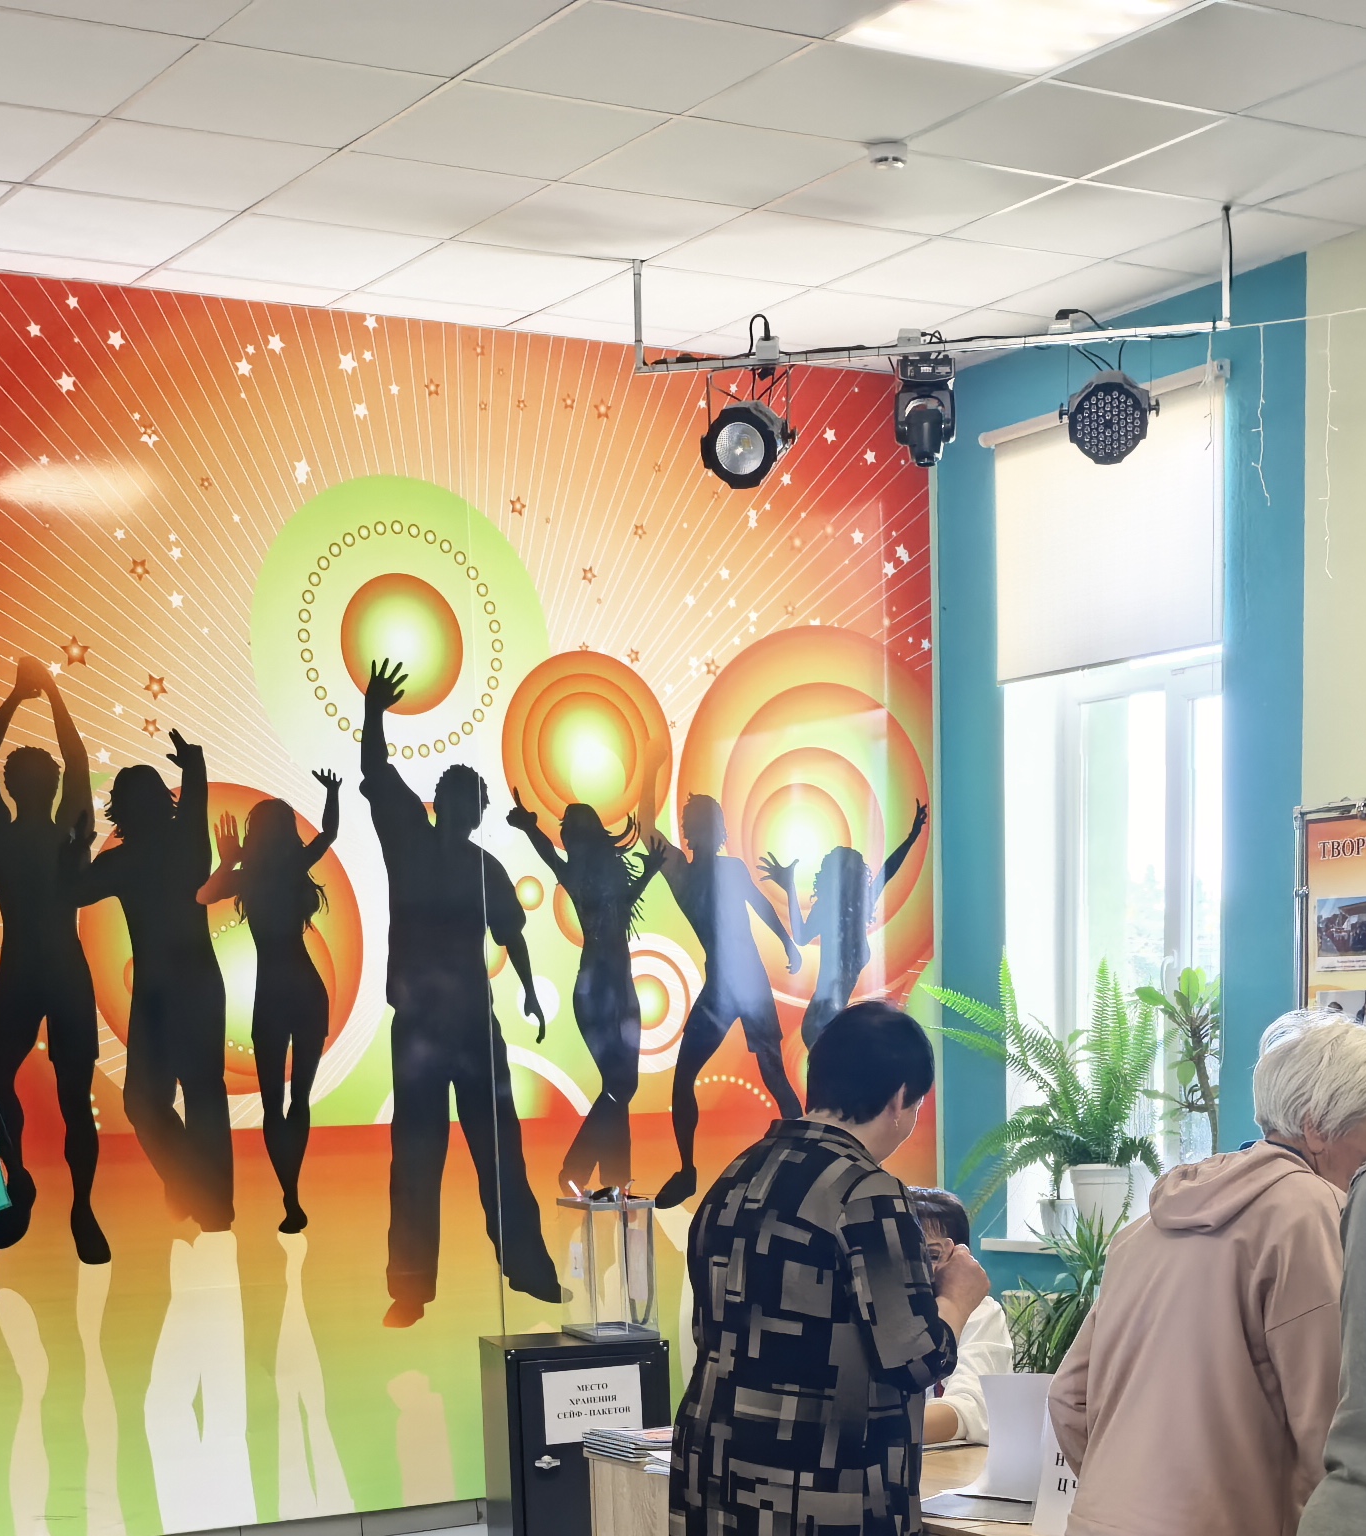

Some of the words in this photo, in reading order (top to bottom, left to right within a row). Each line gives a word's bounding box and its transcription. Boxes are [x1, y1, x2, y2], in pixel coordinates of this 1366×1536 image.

[576, 1382, 609, 1392] МЕСТО
[569, 1394, 617, 1406] ХРАНЕНИЯ
[557, 1409, 583, 1420] СЕЙФ
[589, 1405, 631, 1417] ПАКЕТОВ
